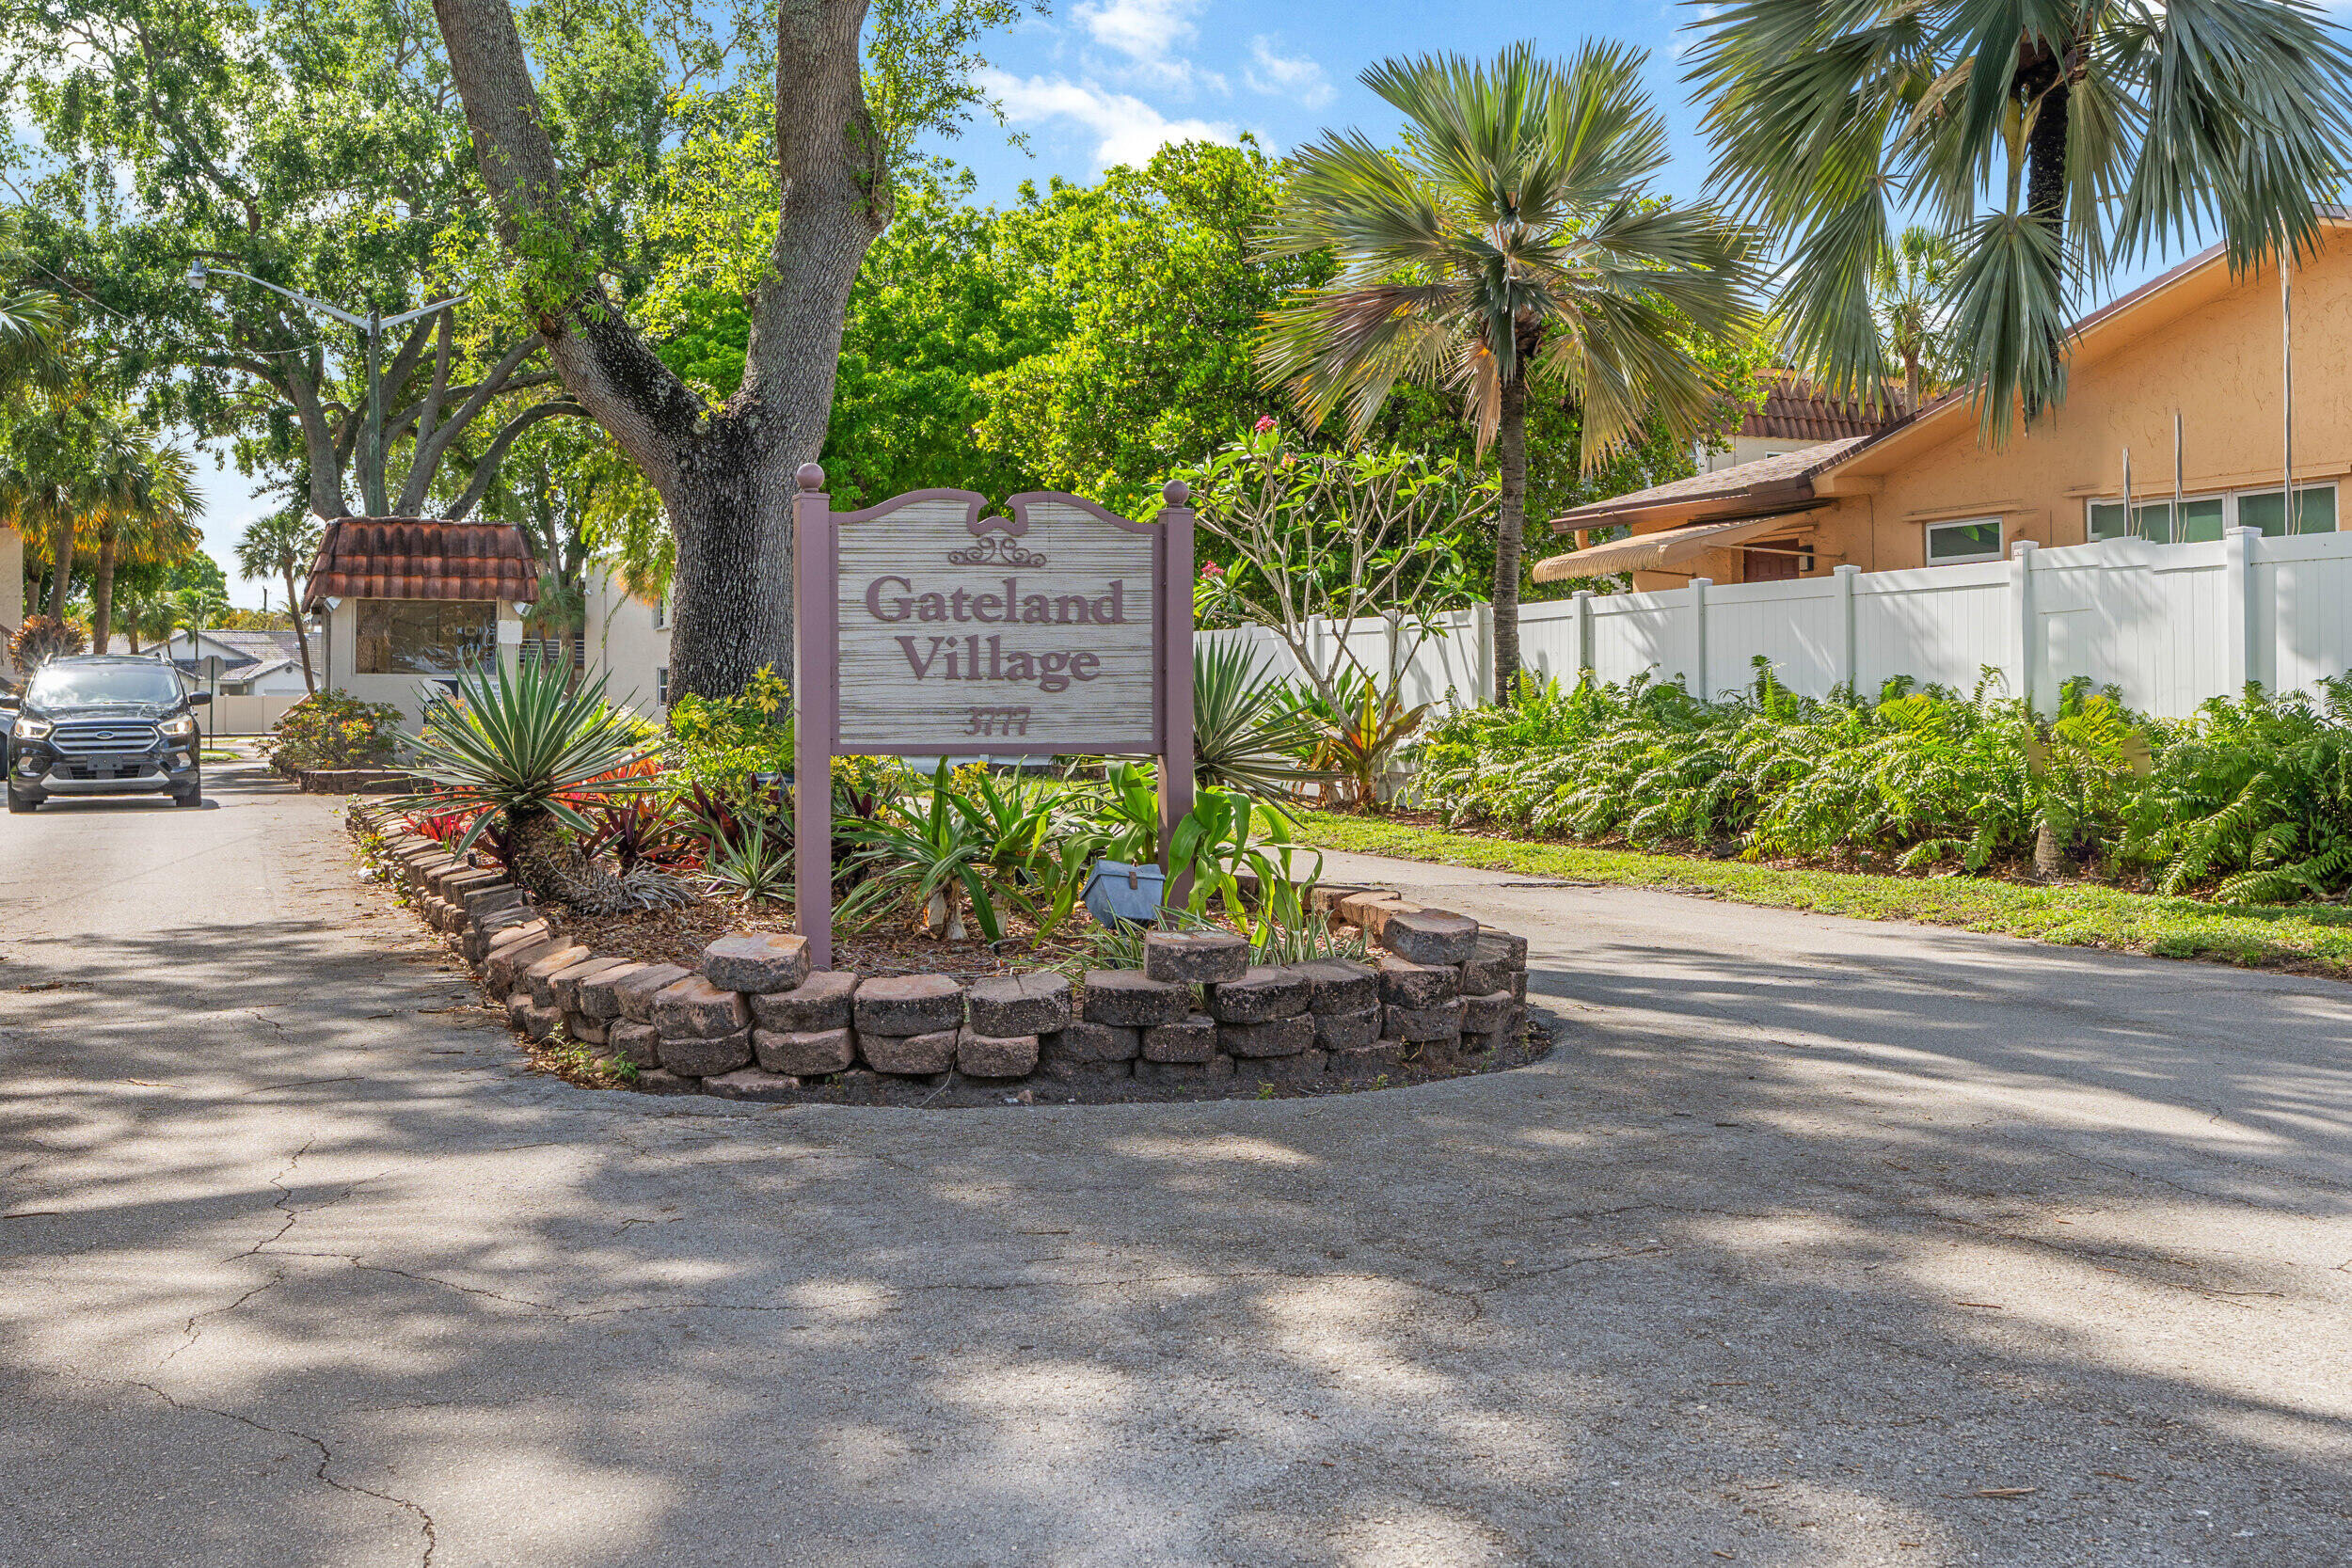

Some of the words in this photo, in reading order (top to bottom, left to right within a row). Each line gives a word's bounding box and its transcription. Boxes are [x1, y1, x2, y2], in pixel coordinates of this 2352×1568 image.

[866, 575, 1127, 624] Gateland
[895, 634, 1101, 692] Village
[964, 706, 1031, 736] 3777
